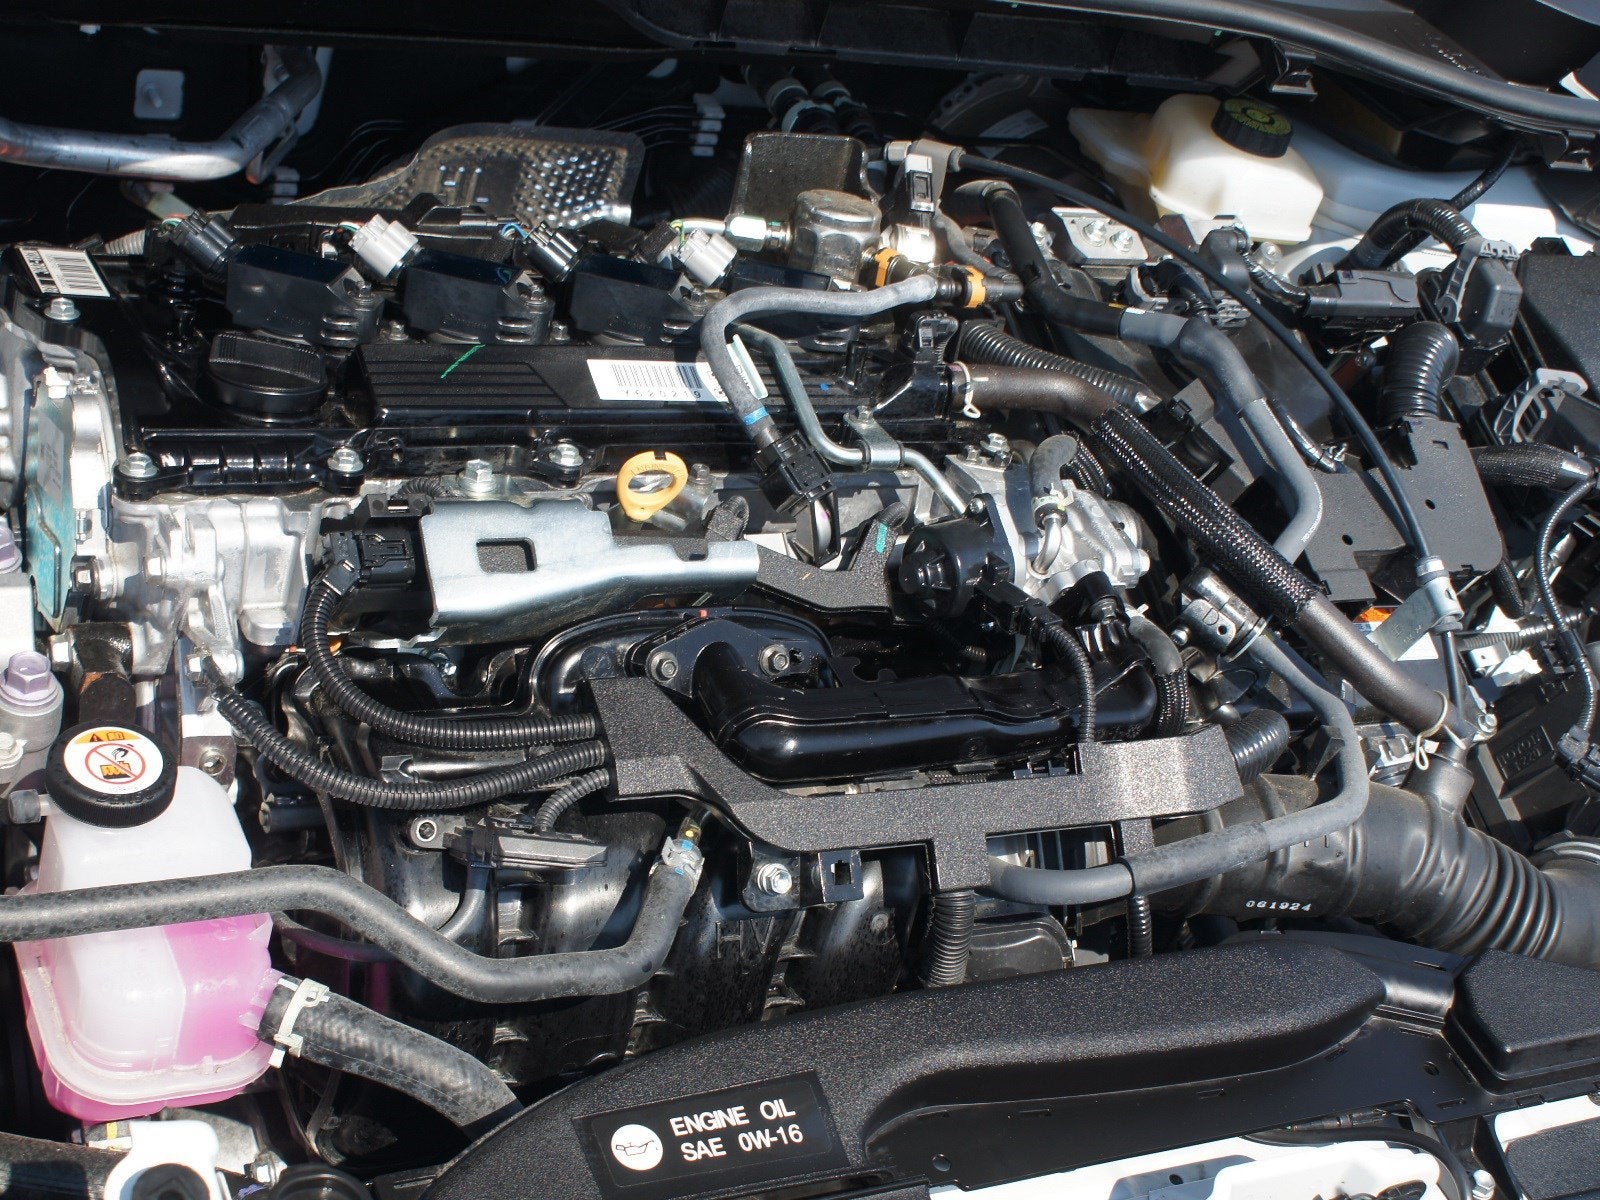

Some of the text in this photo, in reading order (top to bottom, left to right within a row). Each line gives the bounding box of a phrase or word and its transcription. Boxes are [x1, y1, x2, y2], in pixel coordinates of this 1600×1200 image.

[1245, 900, 1312, 912] 061924
[669, 1098, 797, 1137] ENGINE OIL
[680, 1123, 804, 1162] SAE 0W-16
